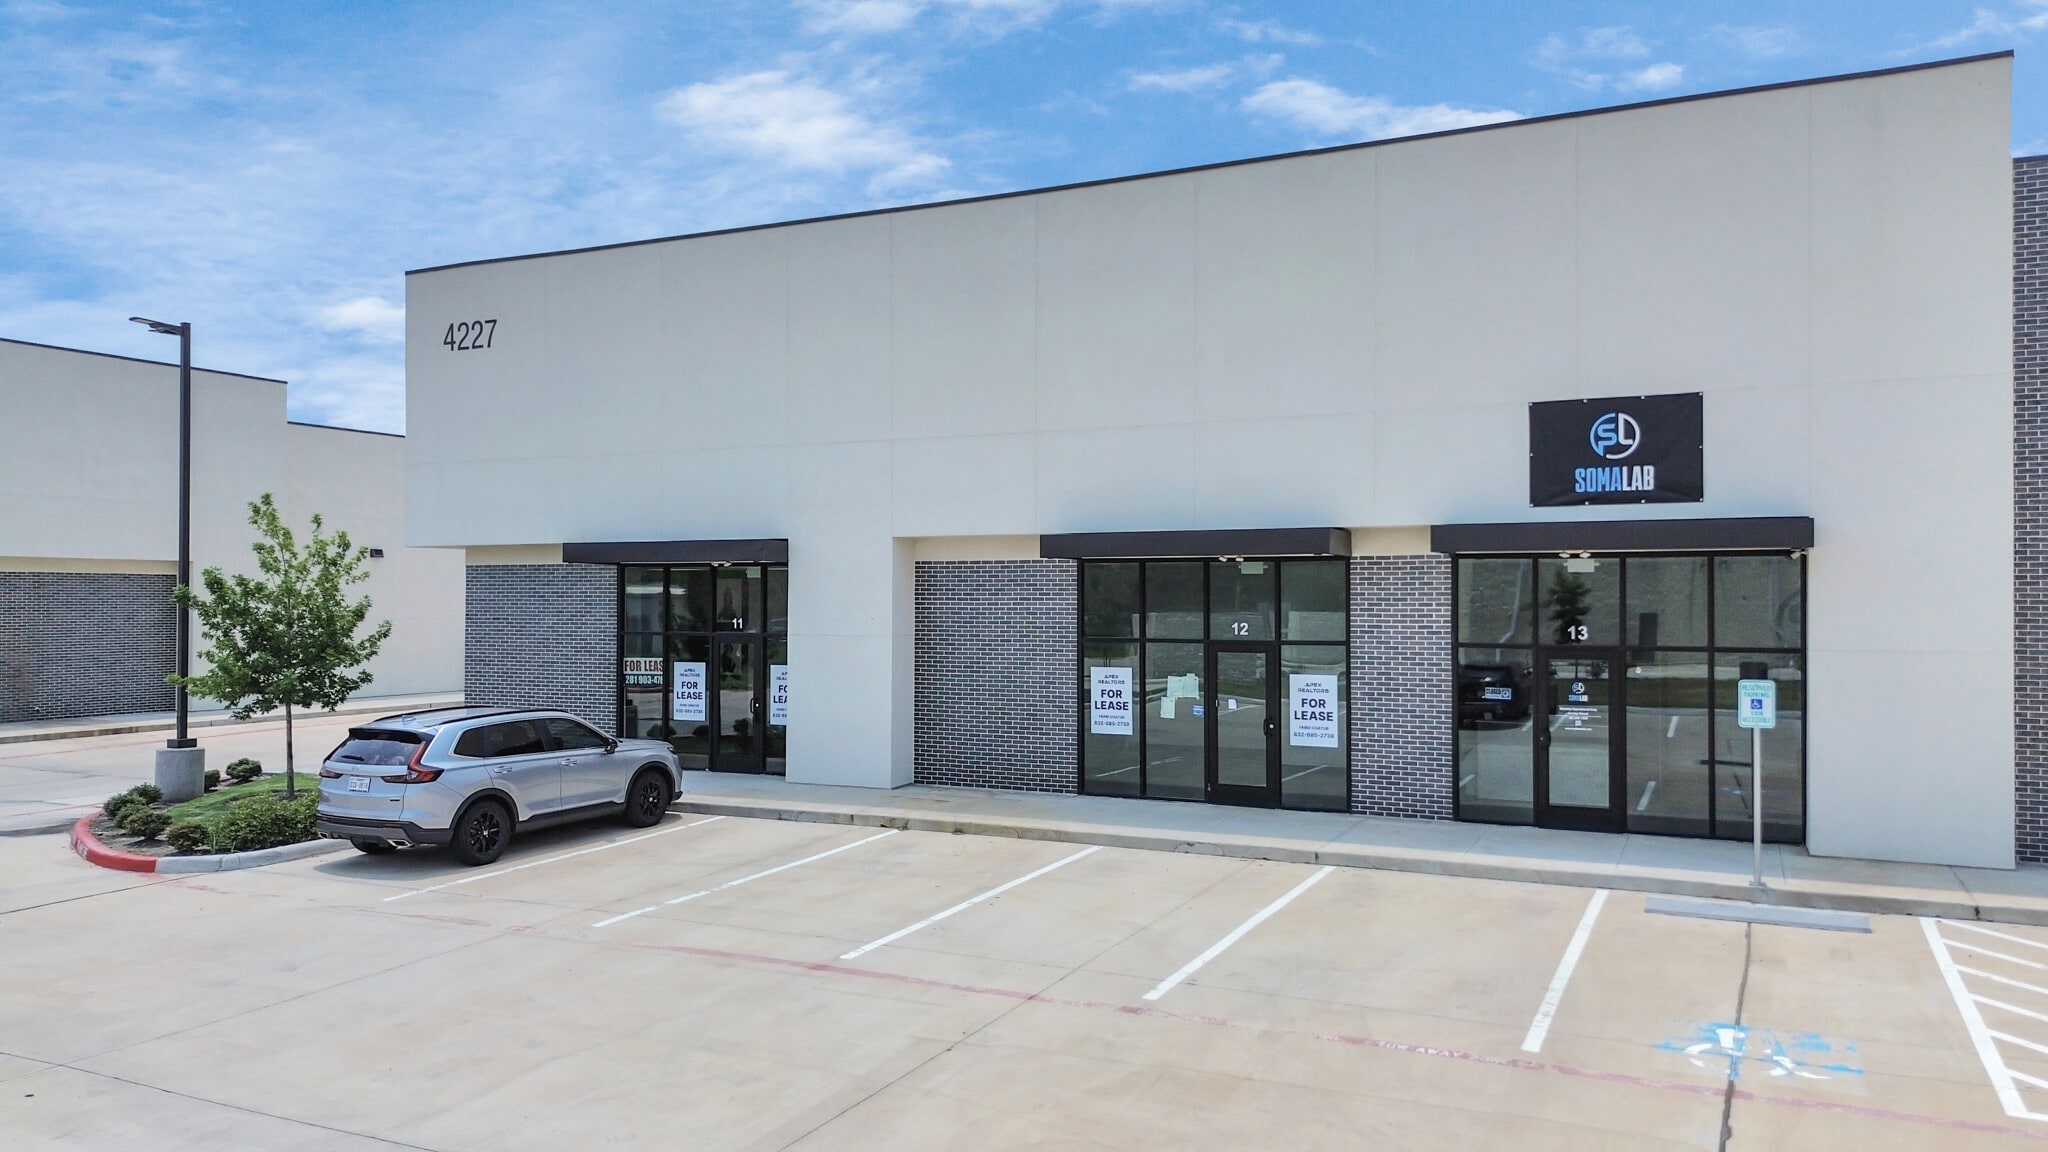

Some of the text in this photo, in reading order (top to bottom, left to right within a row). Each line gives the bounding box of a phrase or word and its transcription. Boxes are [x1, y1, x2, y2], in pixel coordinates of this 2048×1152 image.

[443, 319, 497, 351] 4227
[1574, 465, 1655, 492] SOMALAB
[732, 617, 743, 629] 11
[1231, 622, 1249, 635] 12
[1567, 625, 1588, 641] 13
[624, 660, 641, 672] FOR
[625, 675, 638, 684] 281
[681, 681, 698, 690] FOR
[676, 690, 703, 700] LEASE
[1100, 689, 1123, 699] FOR
[1094, 700, 1129, 711] LEASE
[1301, 698, 1326, 709] FOR
[1294, 710, 1334, 721] LEASE
[1415, 1046, 1461, 1058] AWAY
